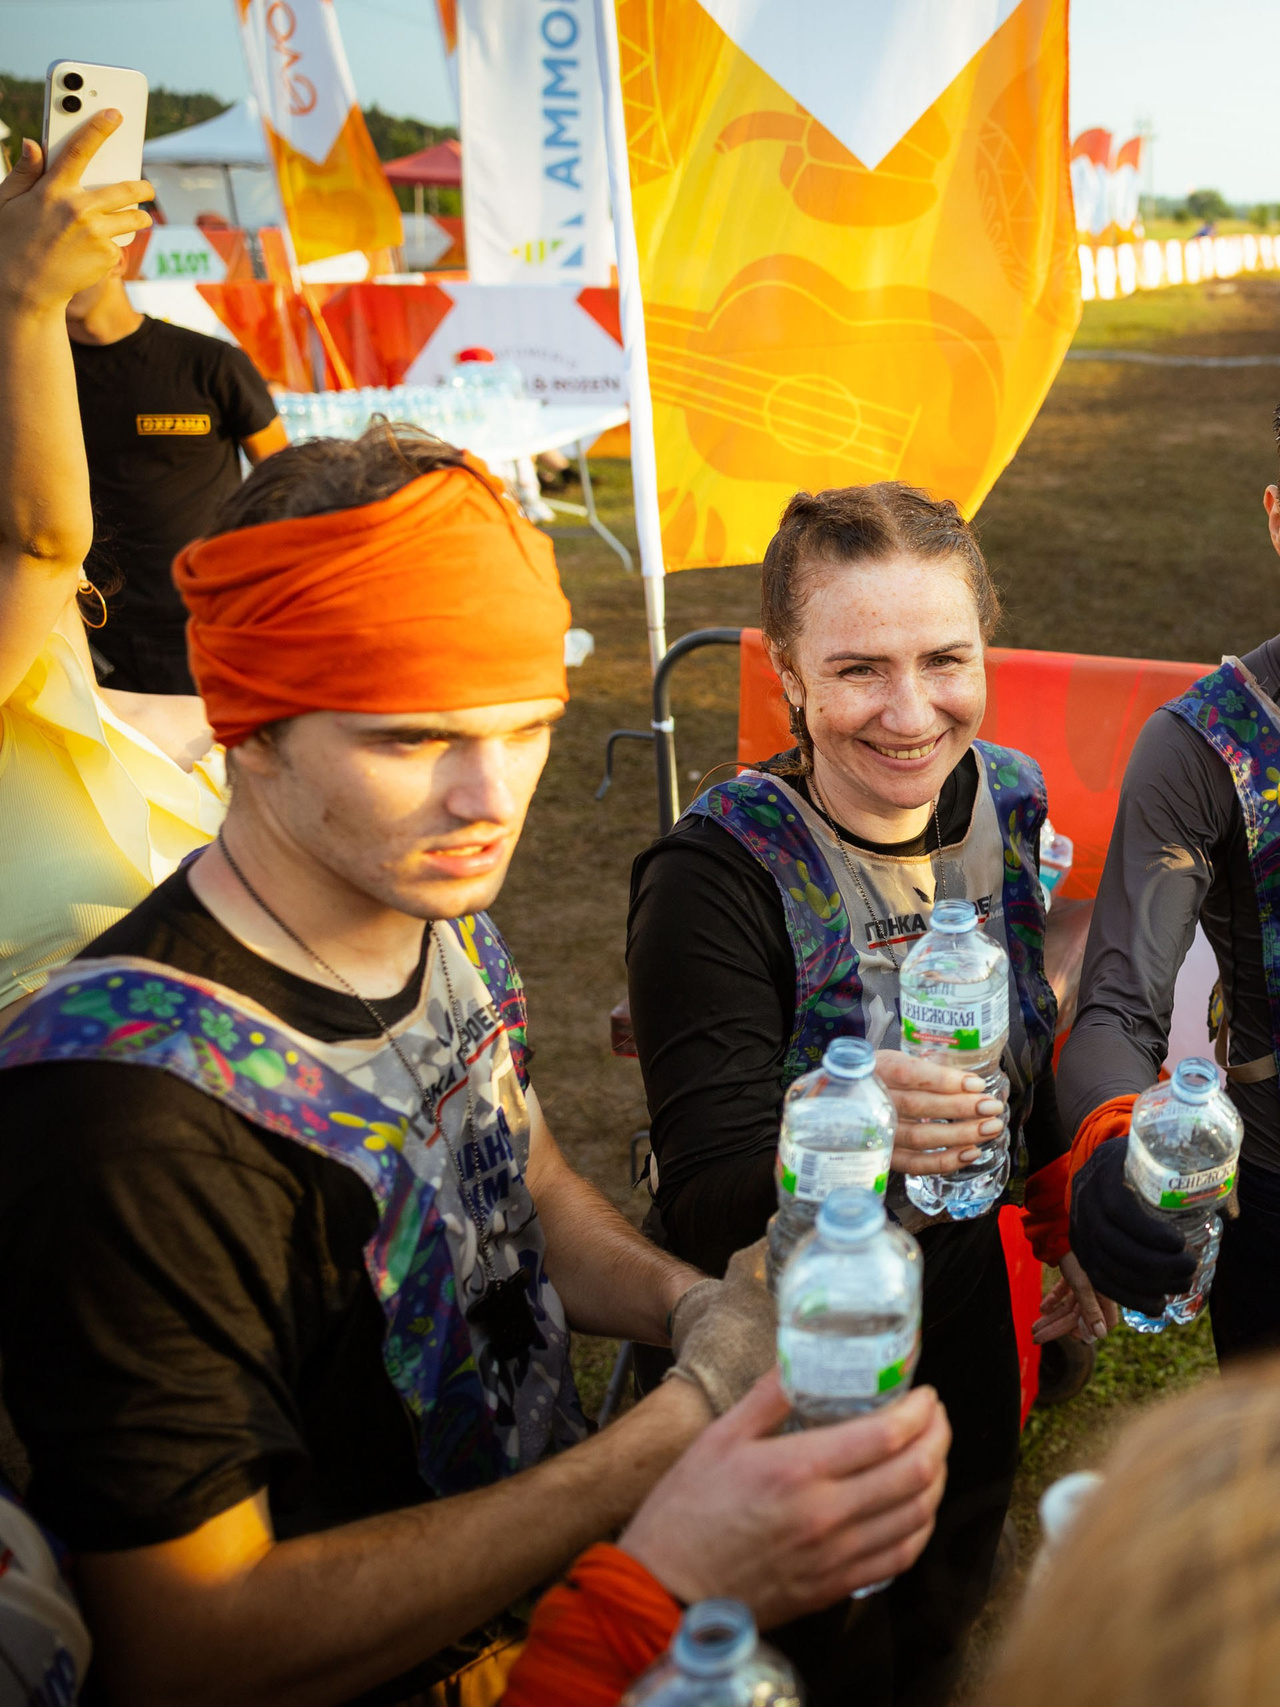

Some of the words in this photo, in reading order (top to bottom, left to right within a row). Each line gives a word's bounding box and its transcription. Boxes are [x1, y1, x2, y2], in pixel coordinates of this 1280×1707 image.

[541, 0, 583, 189] АММО
[864, 913, 927, 941] ГОНКА
[902, 1000, 976, 1028] ЕНЕЖСКАЯ
[1168, 1161, 1235, 1190] СЕНЕЖСКА
